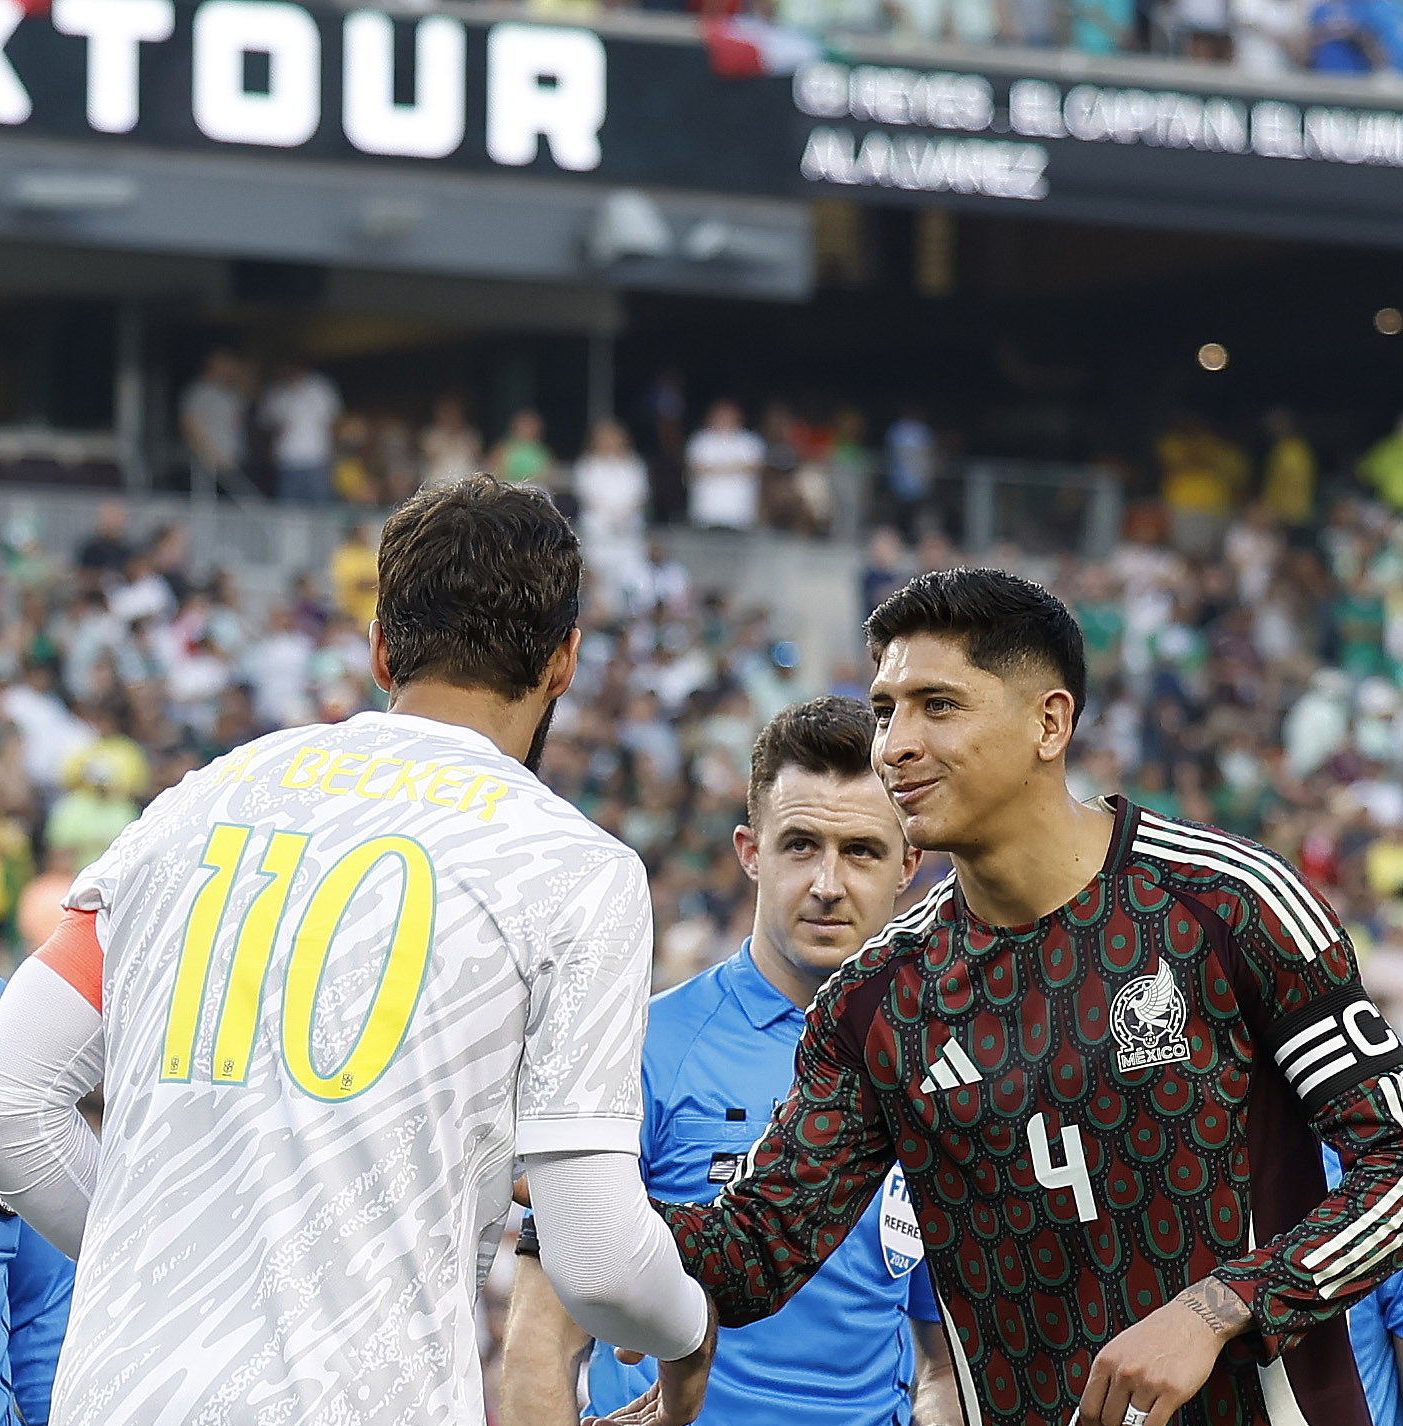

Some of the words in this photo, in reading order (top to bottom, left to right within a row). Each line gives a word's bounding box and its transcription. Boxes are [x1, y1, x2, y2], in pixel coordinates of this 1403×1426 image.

[280, 746, 509, 822] BECKER
[159, 821, 437, 1104] 110
[1120, 1043, 1186, 1068] MÉXICO
[1342, 999, 1399, 1057] C
[1026, 1111, 1099, 1224] 4
[884, 1214, 923, 1239] REFERE
[890, 1252, 910, 1269] 2024
